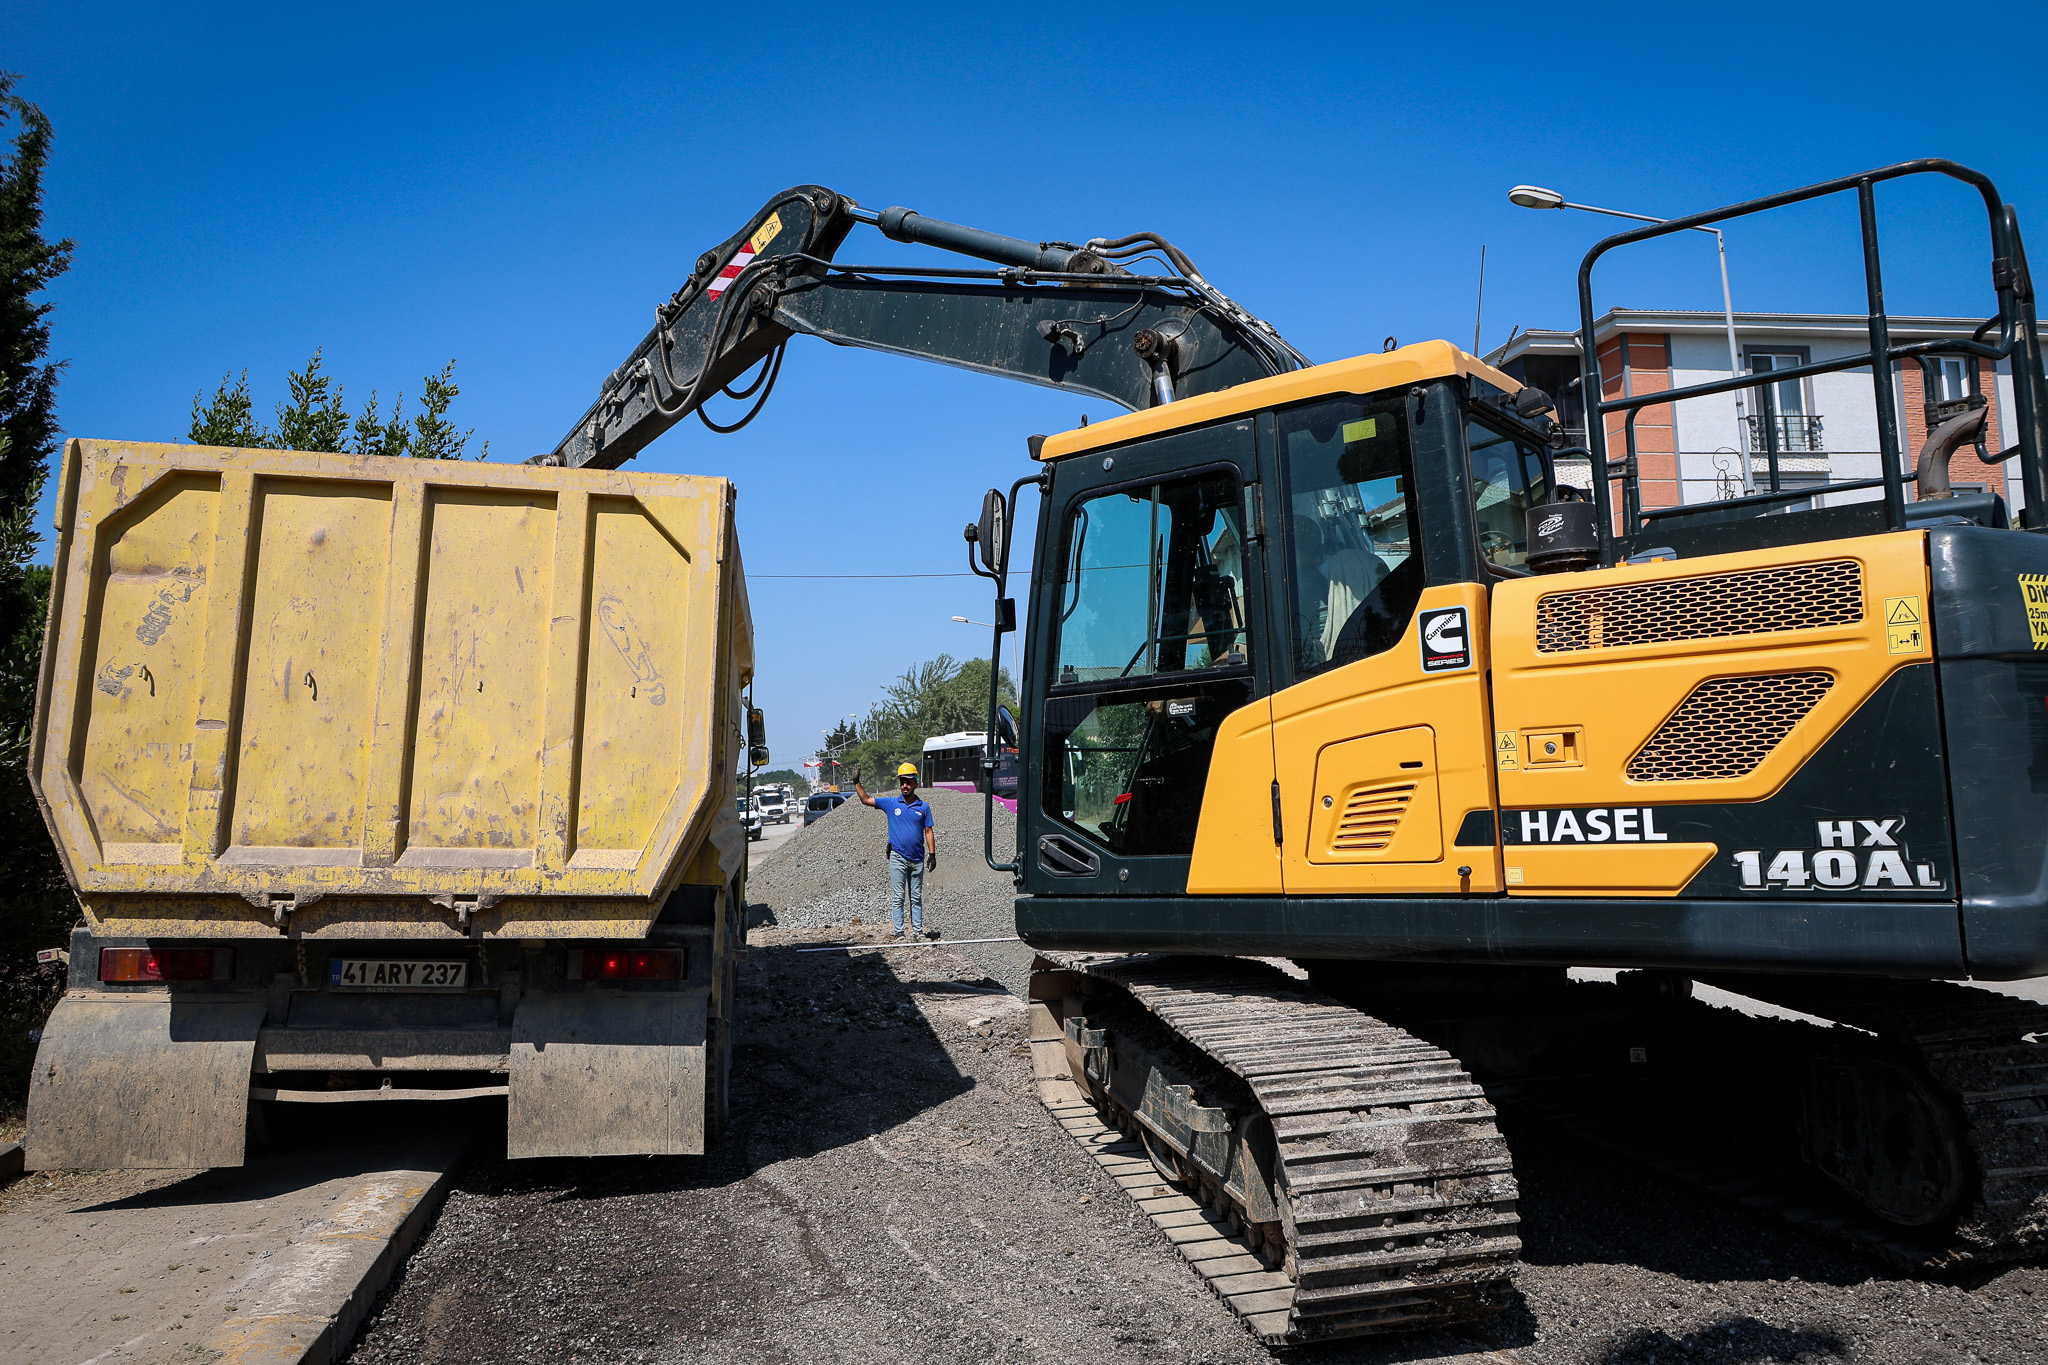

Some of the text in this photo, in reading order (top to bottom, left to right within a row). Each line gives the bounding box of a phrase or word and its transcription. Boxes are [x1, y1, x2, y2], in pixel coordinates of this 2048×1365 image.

[1426, 613, 1457, 641] Cummins
[1427, 657, 1464, 667] SERIES
[1520, 808, 1668, 842] HASEL
[1817, 819, 1898, 847] HX
[1733, 850, 1941, 887] 140AL
[343, 962, 463, 985] 41 ARY 237
